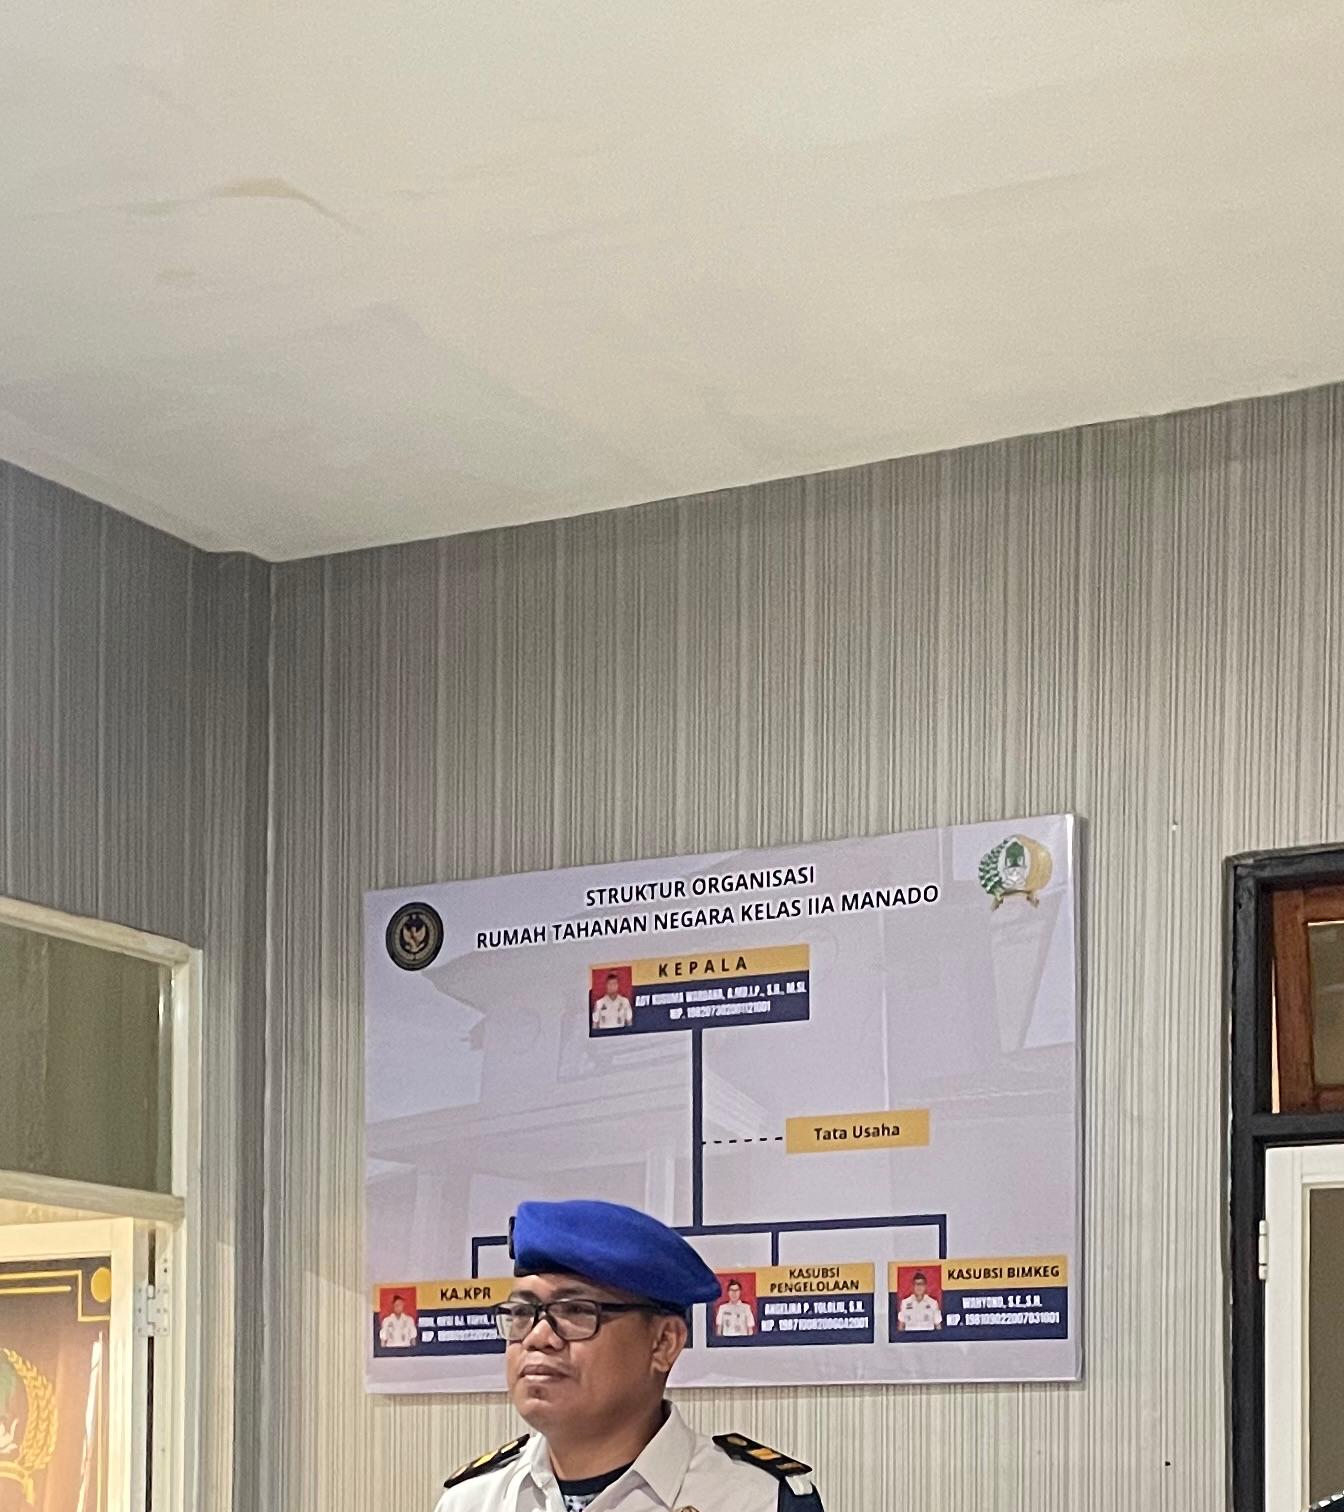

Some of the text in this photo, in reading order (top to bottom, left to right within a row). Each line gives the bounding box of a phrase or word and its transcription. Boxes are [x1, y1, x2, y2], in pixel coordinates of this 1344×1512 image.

[586, 866, 815, 907] STRUKTUR ORGANISASI
[477, 885, 939, 949] RUMAH TAHANAN NEGARA KELAS IIA MANADO
[659, 956, 747, 978] KEPALA
[814, 1123, 900, 1141] Tata Usaha
[789, 1267, 840, 1279] KASUBSI
[948, 1265, 1060, 1280] KASUBSI BIMKEG
[770, 1280, 860, 1293] PENGELOLAAN
